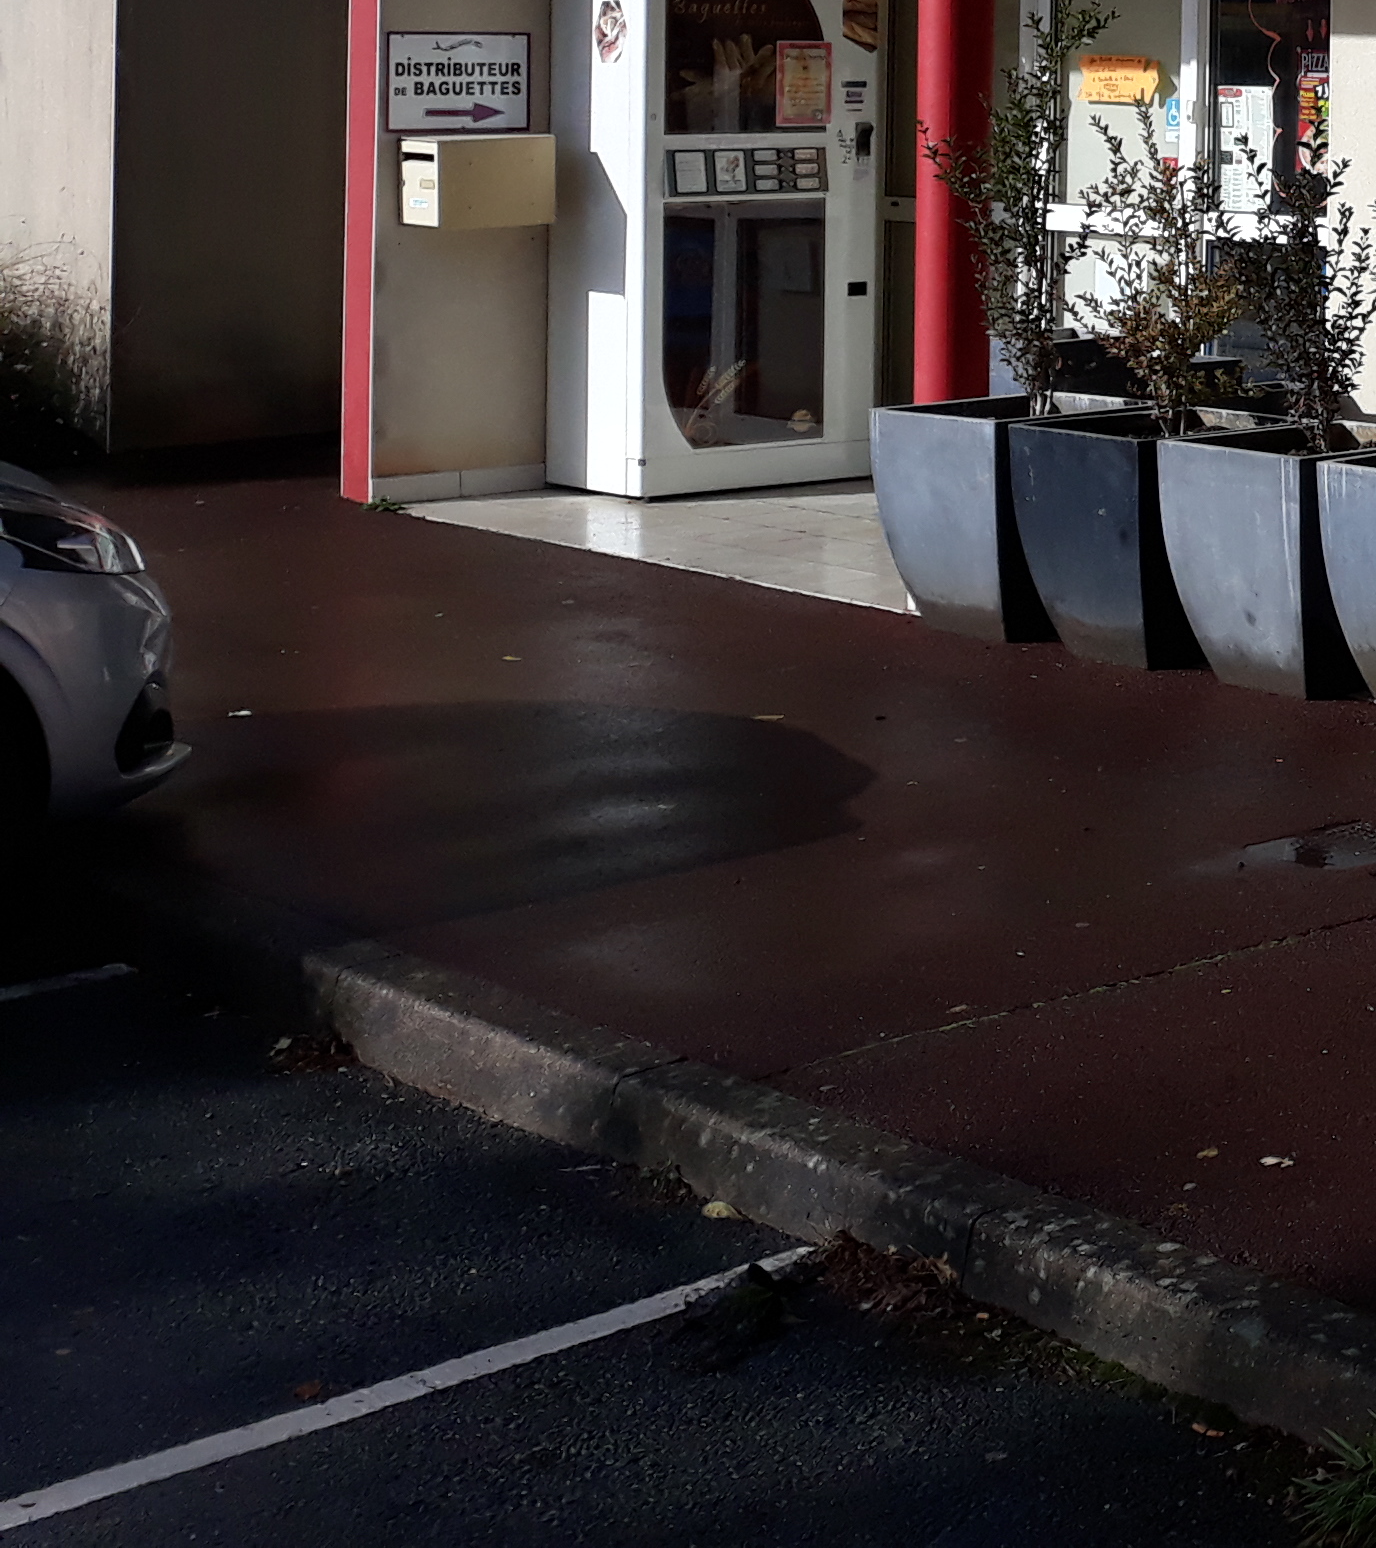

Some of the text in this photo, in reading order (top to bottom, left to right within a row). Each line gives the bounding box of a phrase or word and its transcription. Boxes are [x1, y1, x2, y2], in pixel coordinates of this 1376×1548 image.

[394, 56, 522, 77] DISTRIBUTEUR
[1301, 49, 1329, 76] PIZZA
[394, 80, 522, 96] DE BAGUETTES
